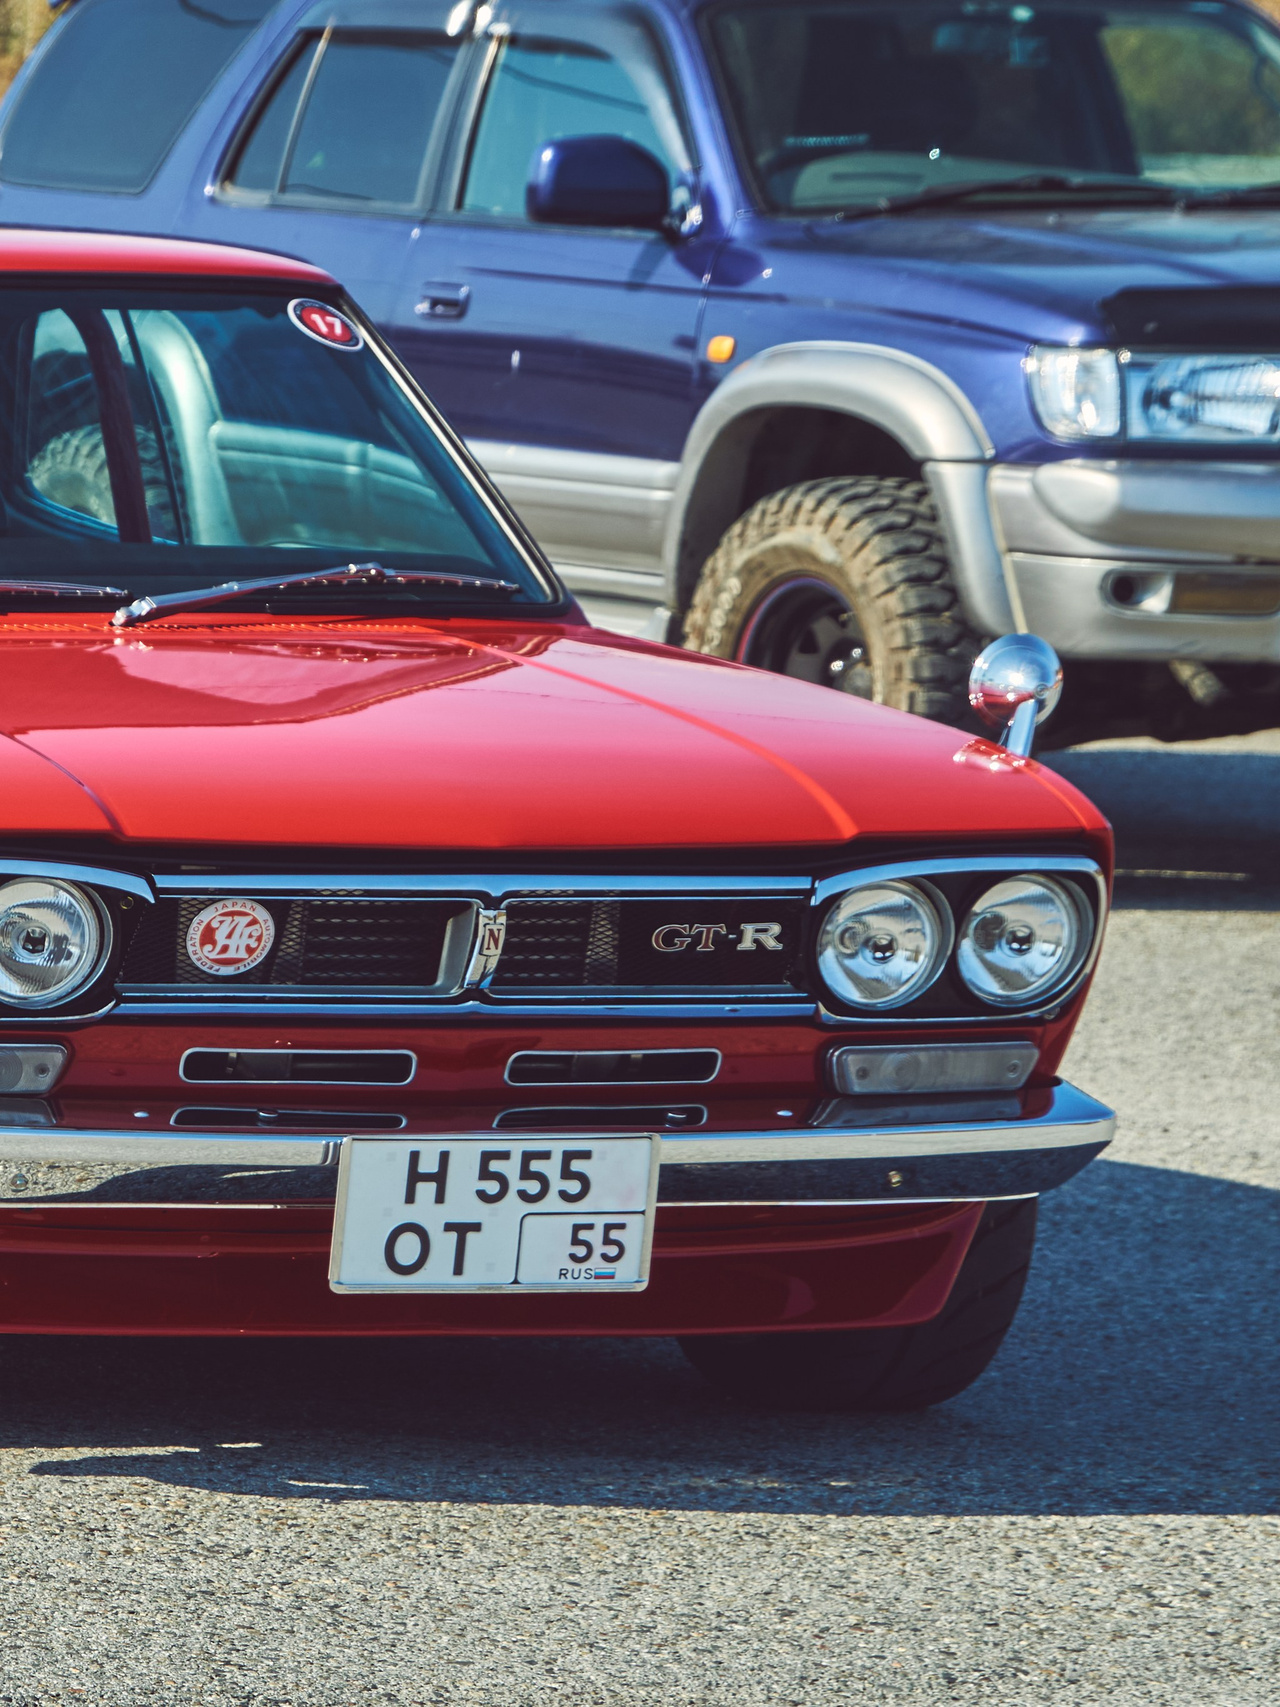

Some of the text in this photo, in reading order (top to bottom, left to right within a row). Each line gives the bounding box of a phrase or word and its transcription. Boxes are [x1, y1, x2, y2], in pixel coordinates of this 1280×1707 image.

[310, 313, 342, 336] 17
[190, 901, 272, 973] JAPAN AUTOMOBILE FEDERATION
[485, 928, 502, 950] N
[651, 922, 784, 952] GT-R
[475, 1149, 592, 1204] 555
[568, 1222, 627, 1264] 55
[558, 1268, 594, 1281] RUS
